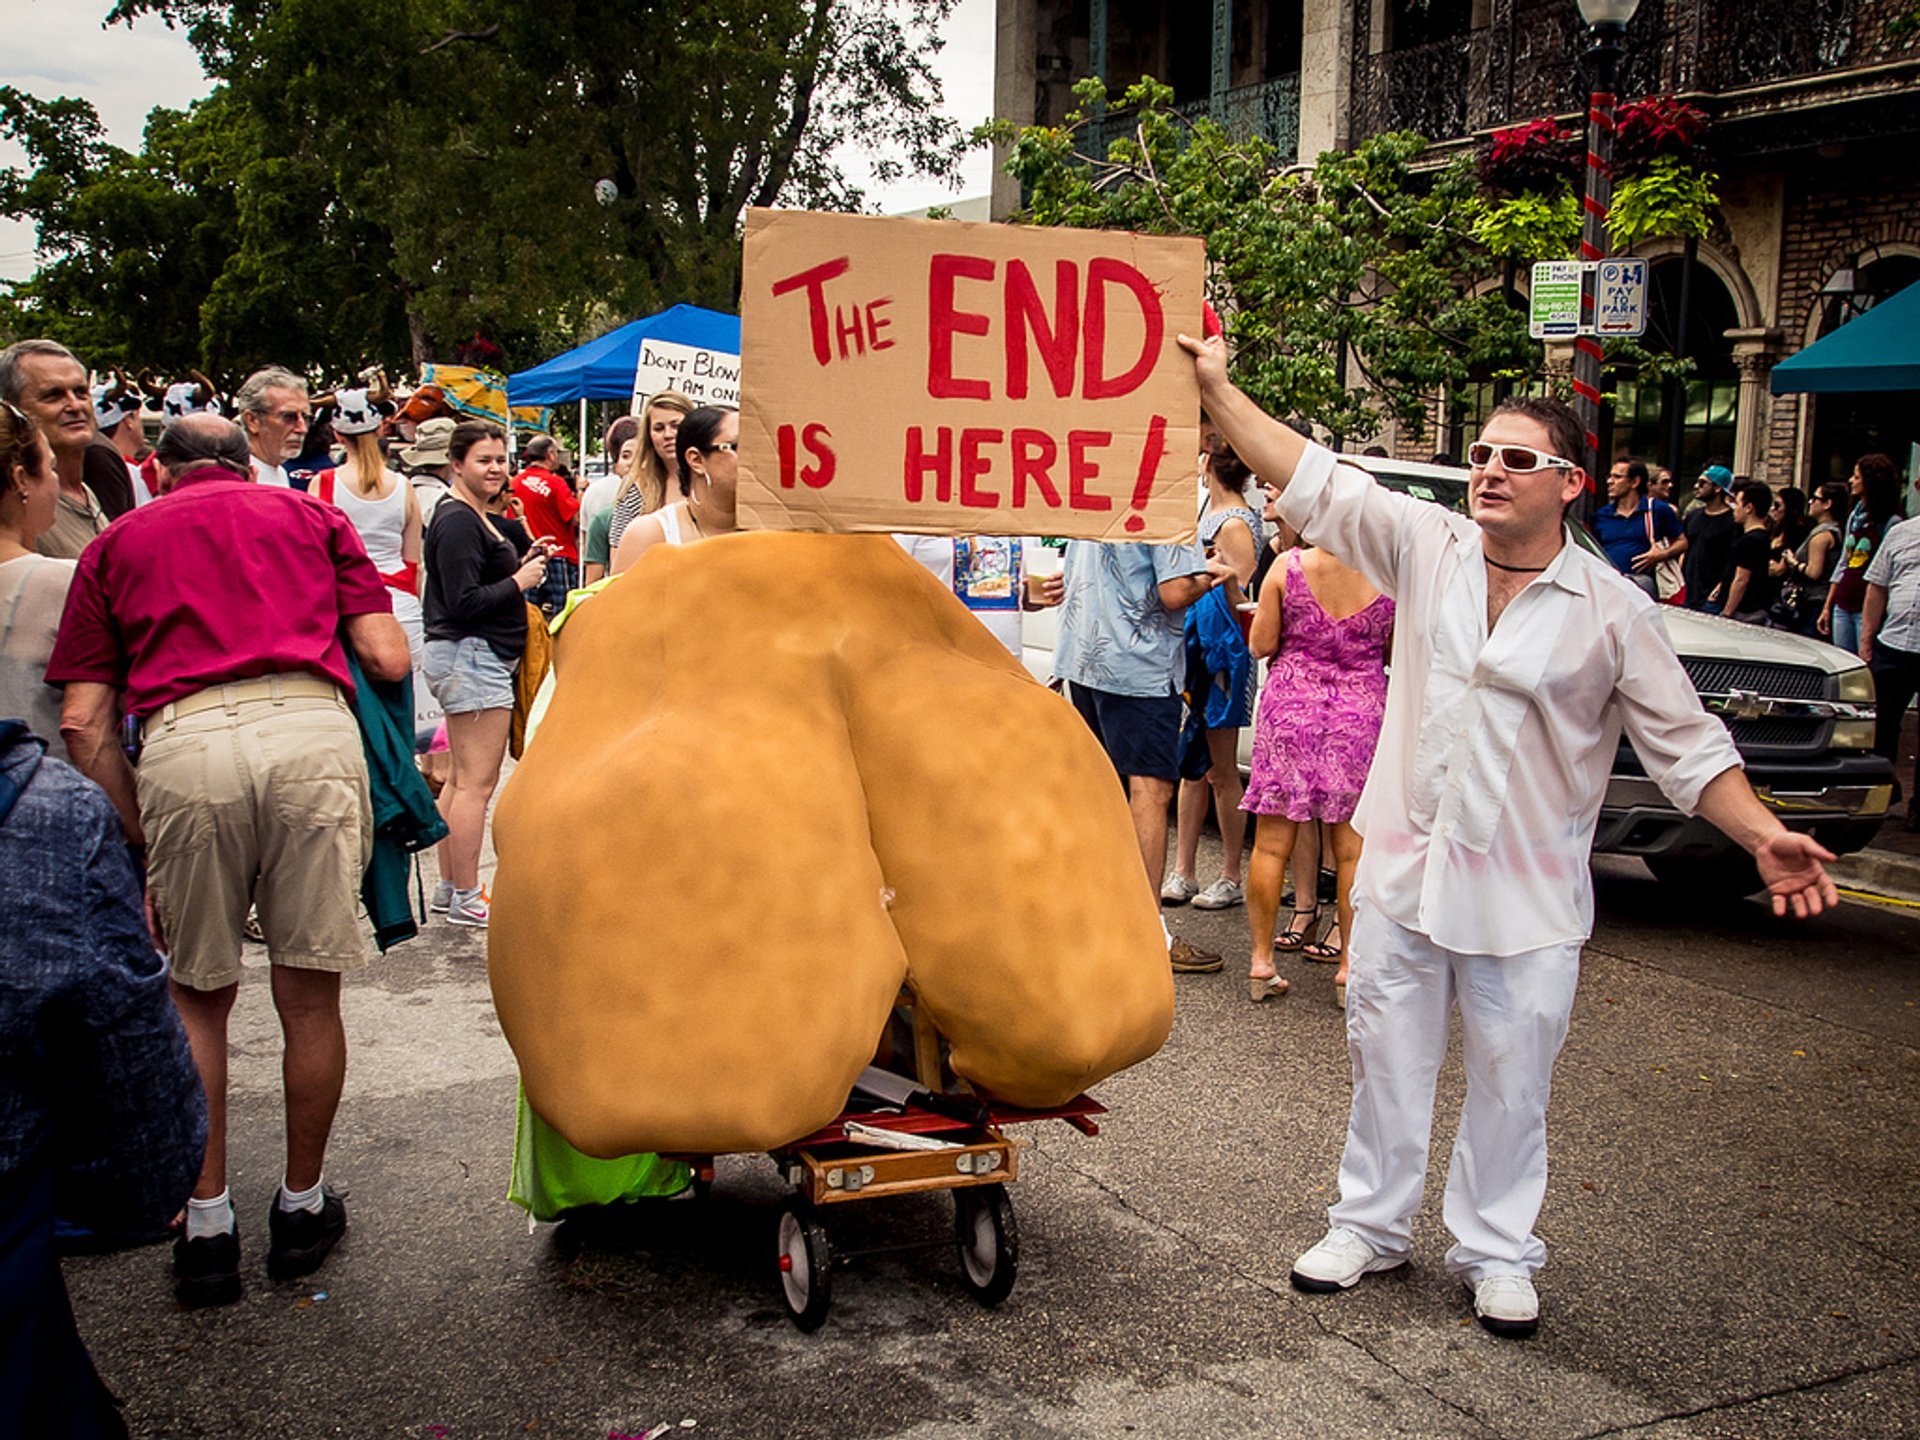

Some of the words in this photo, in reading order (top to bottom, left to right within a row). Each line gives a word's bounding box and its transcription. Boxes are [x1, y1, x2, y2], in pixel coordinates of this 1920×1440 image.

[1607, 287, 1633, 296] PAY
[1613, 296, 1629, 304] TO
[1602, 304, 1638, 314] PARK
[773, 259, 893, 365] THE
[928, 255, 1163, 400] END
[682, 380, 704, 396] AM
[778, 424, 836, 488] IS
[905, 416, 1166, 531] HERE!
